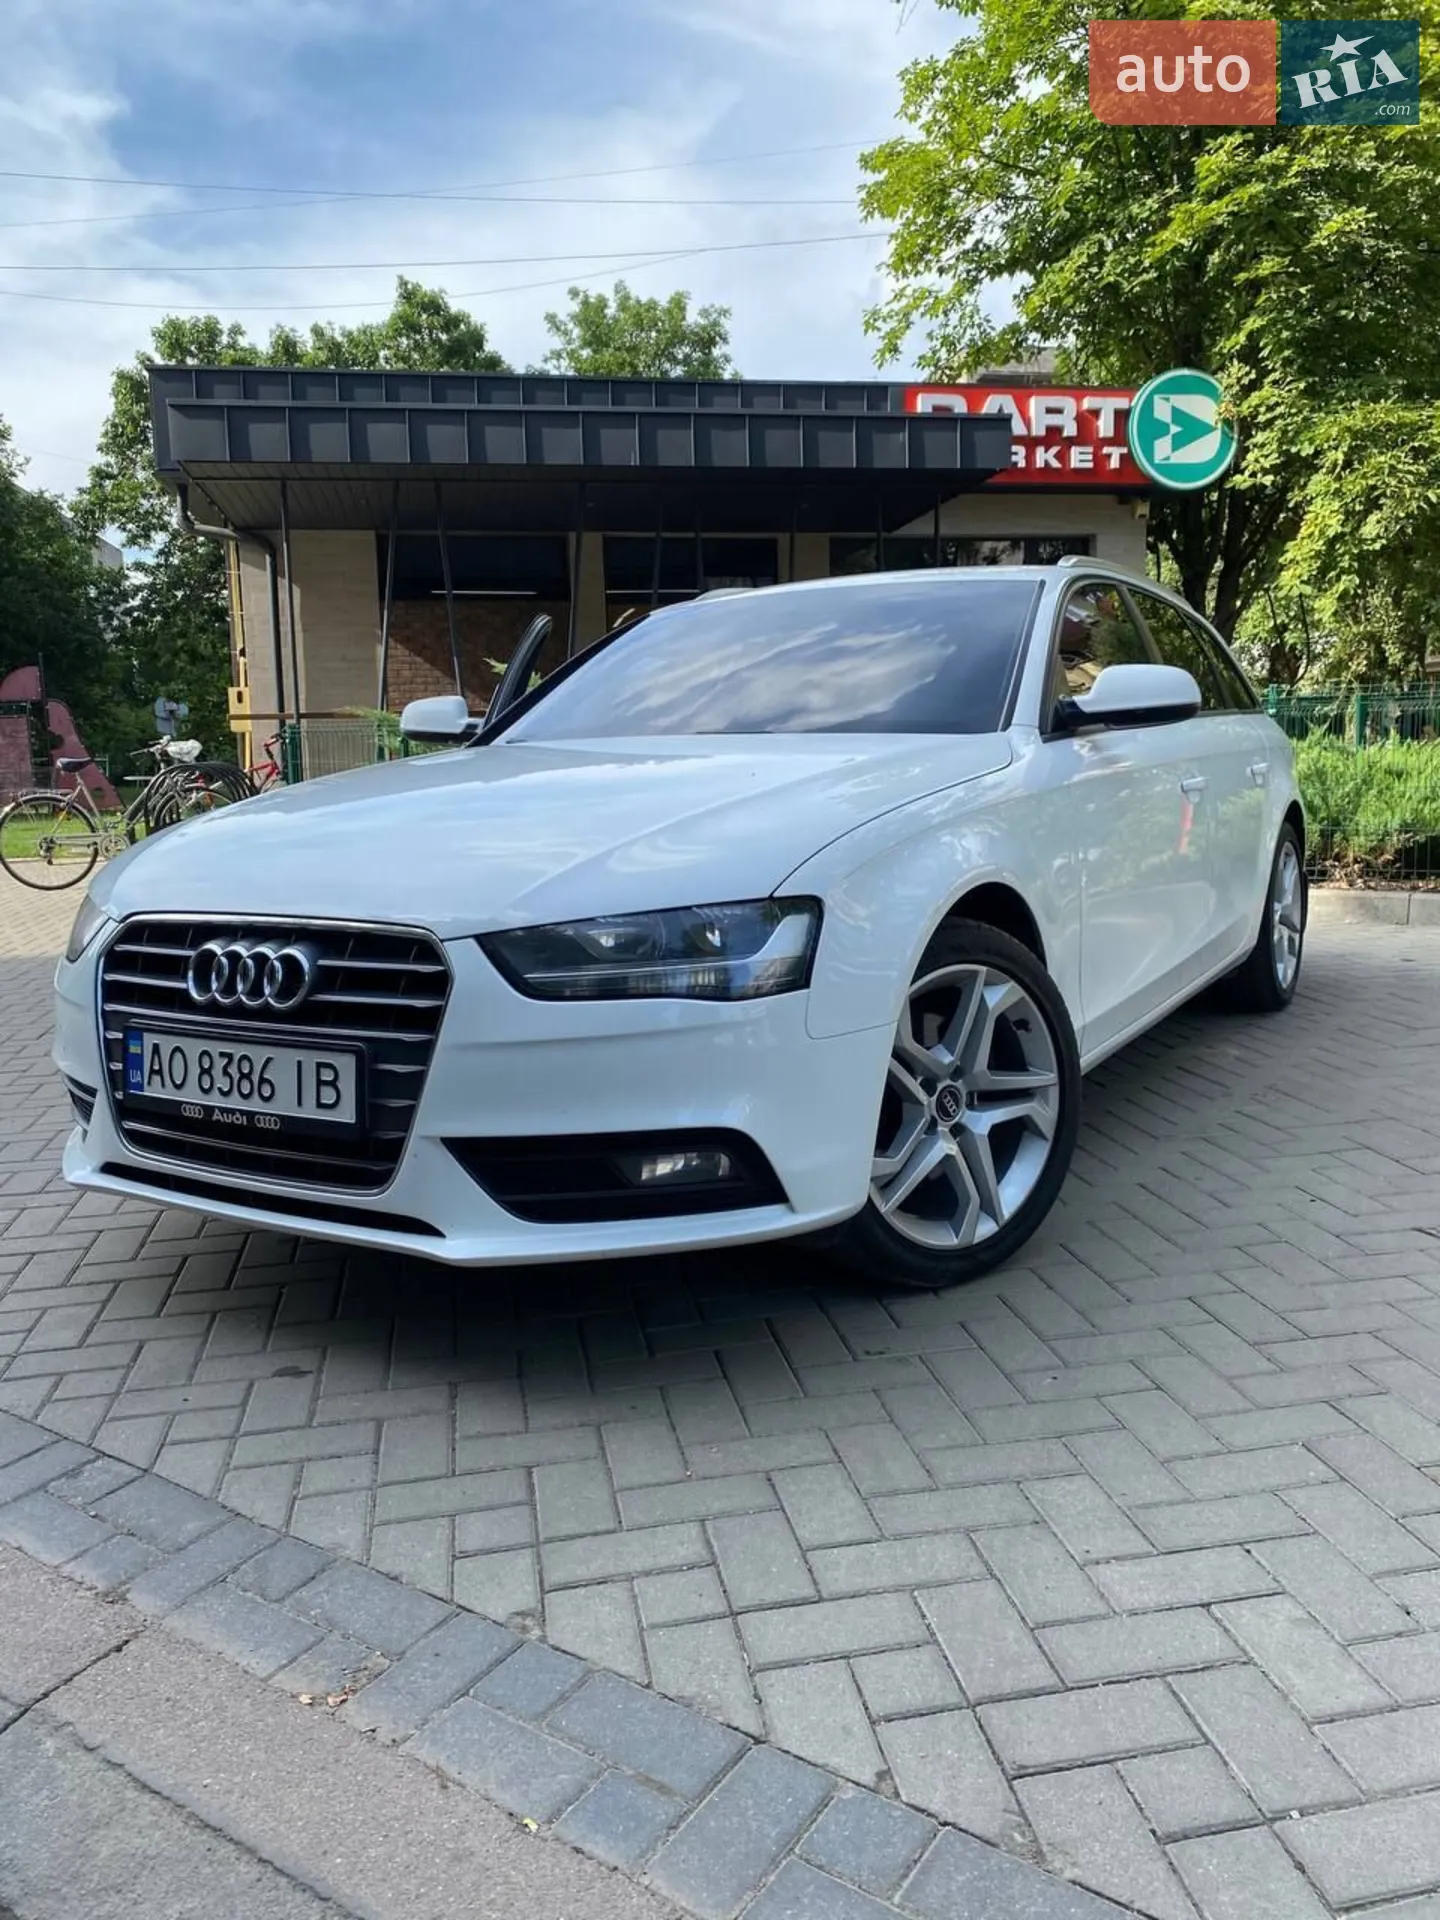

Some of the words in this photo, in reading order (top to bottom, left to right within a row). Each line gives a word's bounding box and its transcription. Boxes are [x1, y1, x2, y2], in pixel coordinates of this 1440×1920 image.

[1011, 445, 1128, 469] RKET
[129, 1069, 143, 1084] UA
[147, 1041, 188, 1091] AO
[197, 1049, 276, 1103] 8386
[296, 1059, 342, 1110] IB
[211, 1109, 248, 1126] Audi
